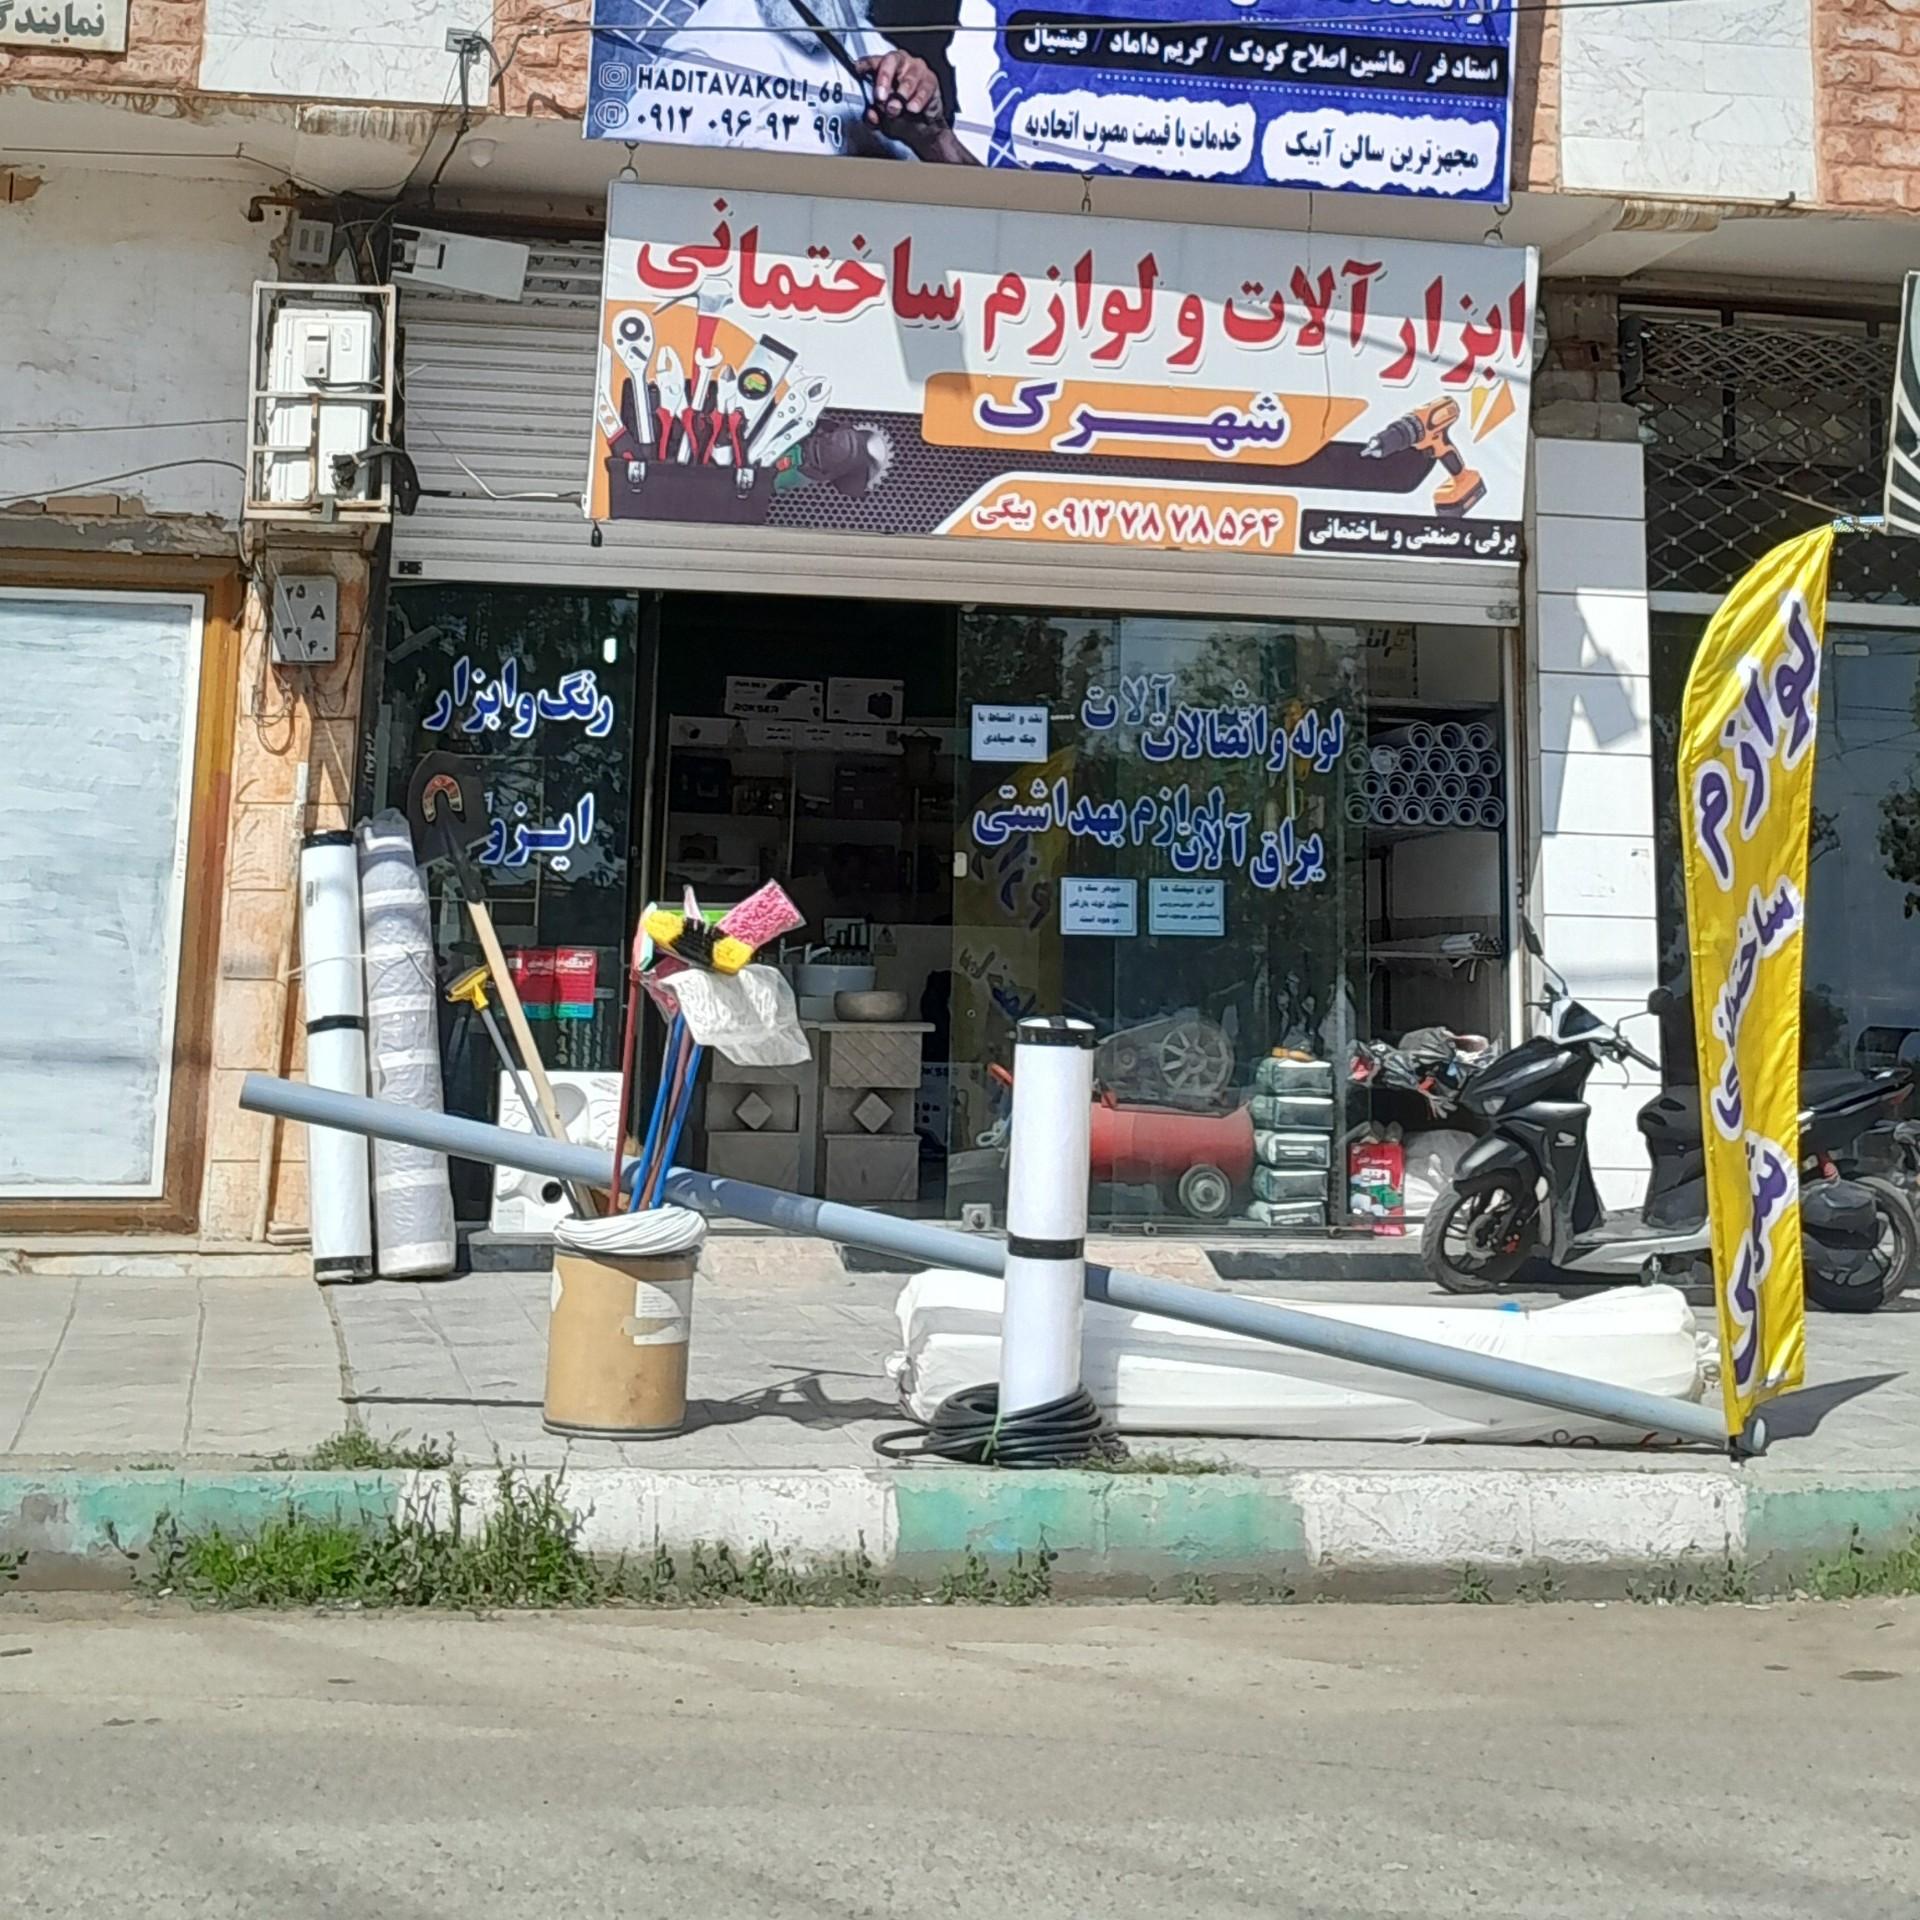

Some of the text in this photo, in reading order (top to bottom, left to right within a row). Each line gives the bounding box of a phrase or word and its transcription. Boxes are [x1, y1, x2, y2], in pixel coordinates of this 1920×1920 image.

[1109, 30, 1160, 55] داماد
[1229, 40, 1288, 71] کودک
[1291, 43, 1346, 73] اصلاح
[1350, 50, 1405, 78] ماشین
[1451, 55, 1498, 81] استاد
[638, 66, 843, 107] HADITAVAKOLI_68
[637, 103, 842, 147] ۰۹۱۲ ۰۹۶ ۹۳ ۹۹
[1025, 108, 1242, 156] خدمات با قیمت مصوب اتحادیه
[1285, 128, 1335, 166] آبیک
[1340, 134, 1384, 169] سالن
[636, 197, 1527, 385] ابزار آلات و لوازم ساختمانی
[978, 382, 1287, 452] شهرک
[1047, 501, 1112, 535] ۰۹۱۲
[1120, 506, 1161, 540] ۷۸
[1168, 509, 1210, 541] ۷۸
[1218, 511, 1280, 544] ۵۶۴
[1309, 517, 1389, 544] ساختمانی
[1391, 530, 1403, 549] و
[1406, 526, 1460, 549] صنعتی
[422, 655, 614, 738] رنگ و ابزار
[1081, 673, 1177, 730] آلات
[1142, 704, 1345, 773] لوله و اتصالات
[1697, 597, 1818, 882] لوازم
[972, 776, 1225, 847] لوازم بهداشتی
[1171, 812, 1327, 888] یراق آلات
